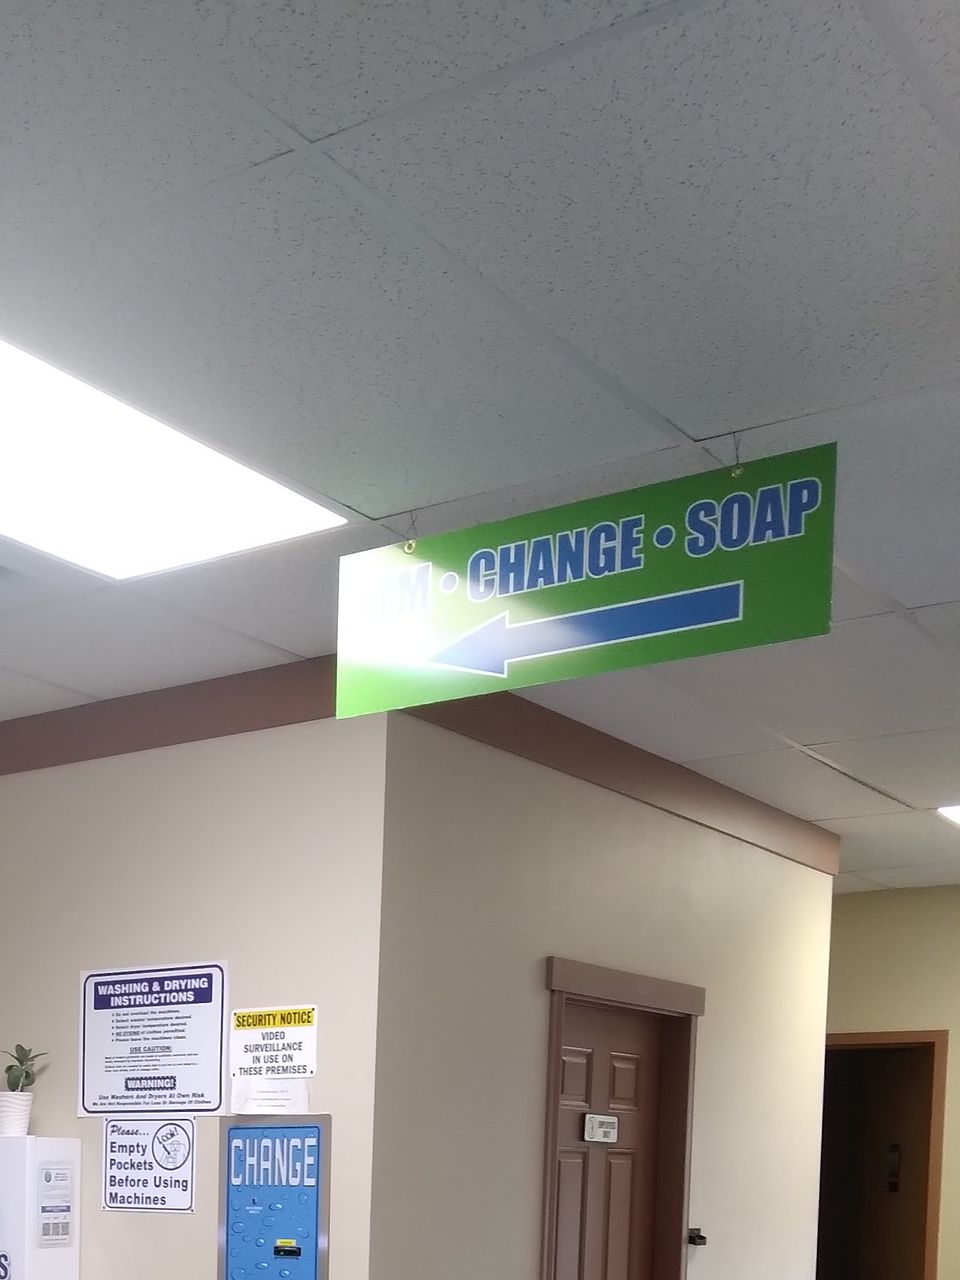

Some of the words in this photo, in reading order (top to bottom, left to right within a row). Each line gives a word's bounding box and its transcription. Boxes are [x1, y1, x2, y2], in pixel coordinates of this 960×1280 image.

[467, 514, 644, 603] CHANGE
[684, 477, 822, 558] SOAP
[98, 982, 149, 995] WASHING
[152, 981, 161, 992] &
[164, 978, 208, 991] DRYING
[110, 991, 194, 1006] INSTRUCTIONS
[235, 1013, 277, 1028] SECURITY
[280, 1010, 312, 1024] NOTICE
[261, 1031, 285, 1041] VIDEO
[244, 1041, 303, 1053] SURVEILLANCE
[252, 1055, 261, 1064] IN
[263, 1054, 279, 1064] USE
[282, 1054, 293, 1063] ON
[239, 1066, 263, 1076] THESE
[265, 1065, 307, 1075] PREMISES
[127, 1079, 174, 1088] WARNING!
[110, 1141, 147, 1156] Empty
[109, 1158, 154, 1170] Pockets
[231, 1137, 317, 1186] CHANGE
[109, 1175, 149, 1187] Before
[153, 1176, 188, 1192] Using
[109, 1192, 166, 1205] Machines
